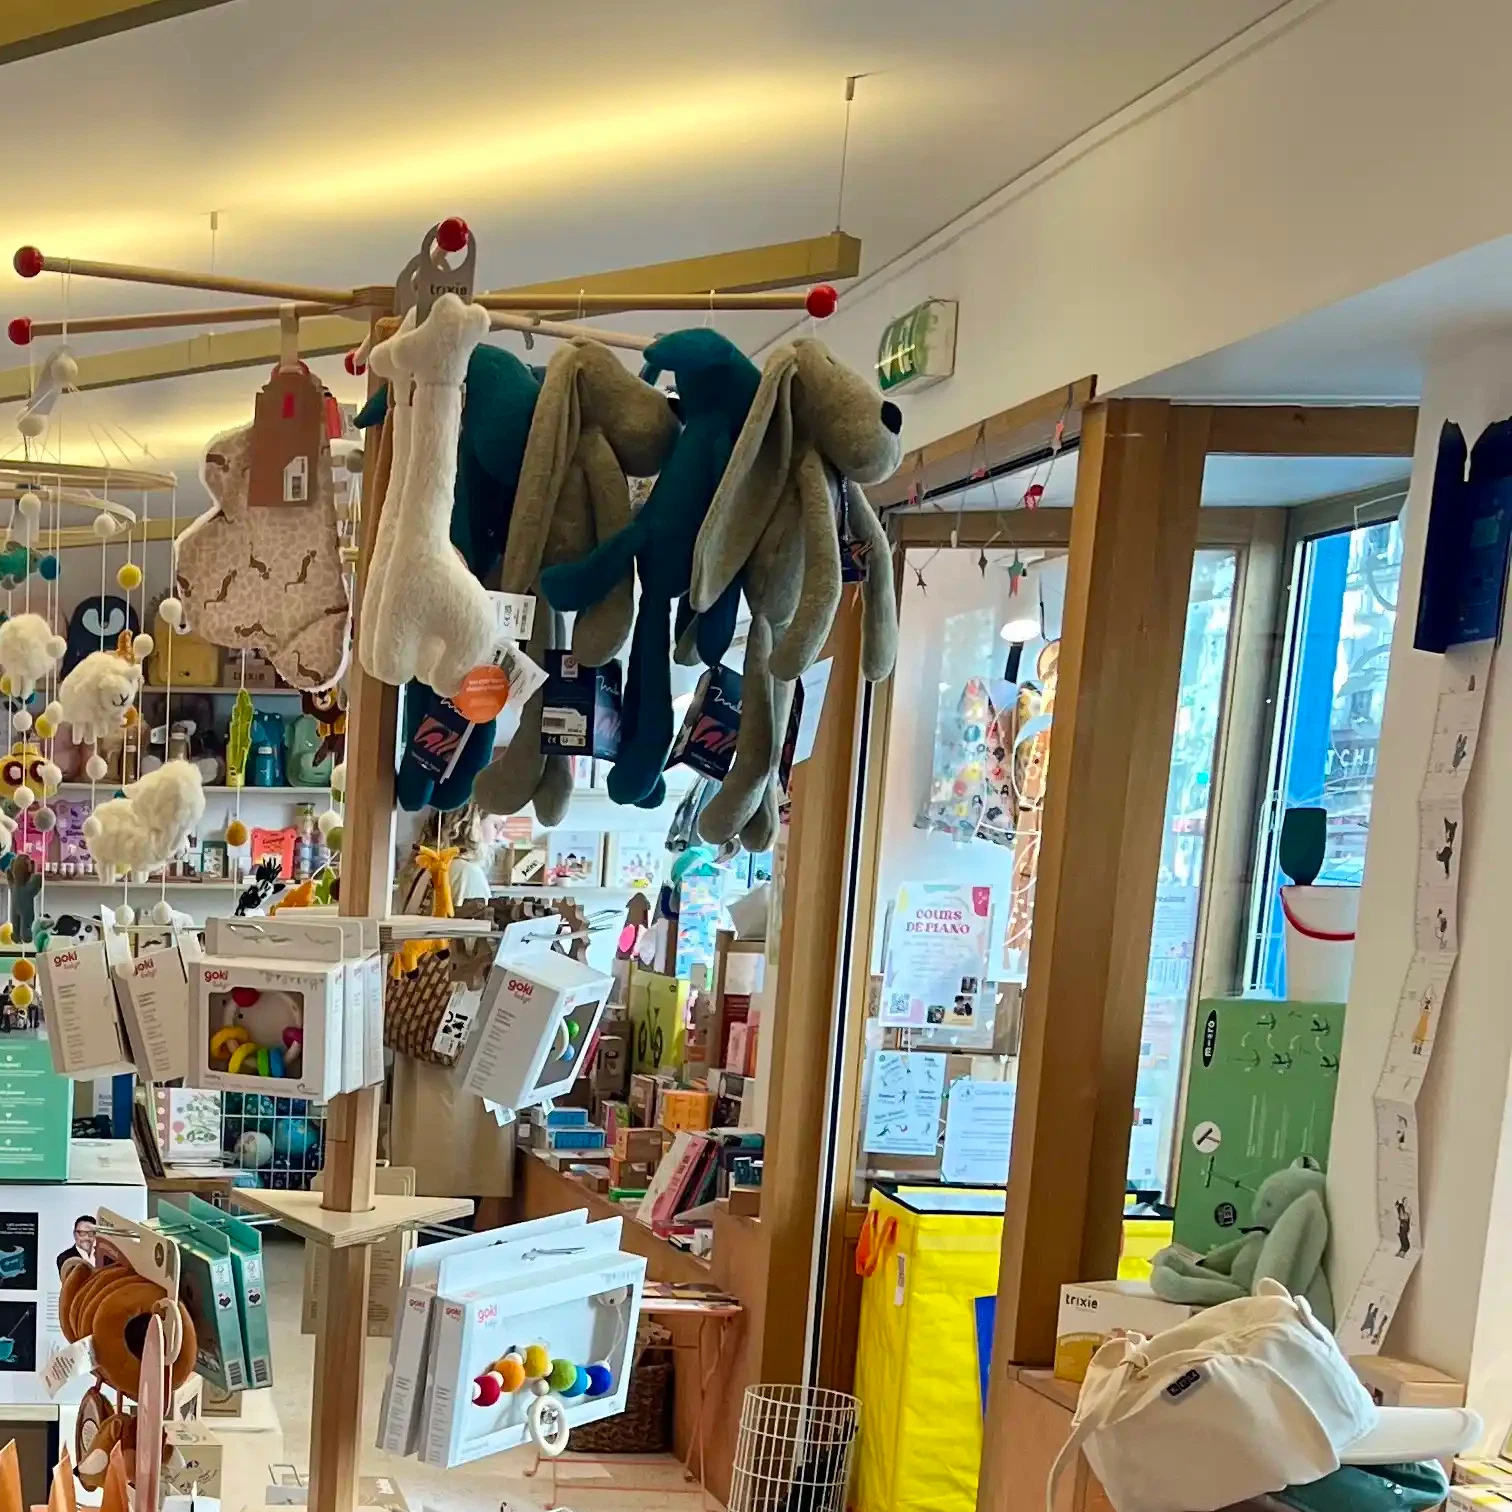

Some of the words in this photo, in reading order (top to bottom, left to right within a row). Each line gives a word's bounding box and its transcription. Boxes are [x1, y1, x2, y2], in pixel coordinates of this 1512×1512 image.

[430, 284, 467, 295] trixie
[916, 908, 963, 921] COURS
[906, 921, 924, 933] DE
[925, 922, 970, 934] PIANO
[53, 951, 78, 967] goki
[204, 969, 228, 982] goki
[508, 979, 533, 995] goki
[409, 1299, 425, 1309] goki
[1065, 1293, 1098, 1309] trixie
[445, 1306, 461, 1317] goki
[477, 1304, 497, 1323] goki
